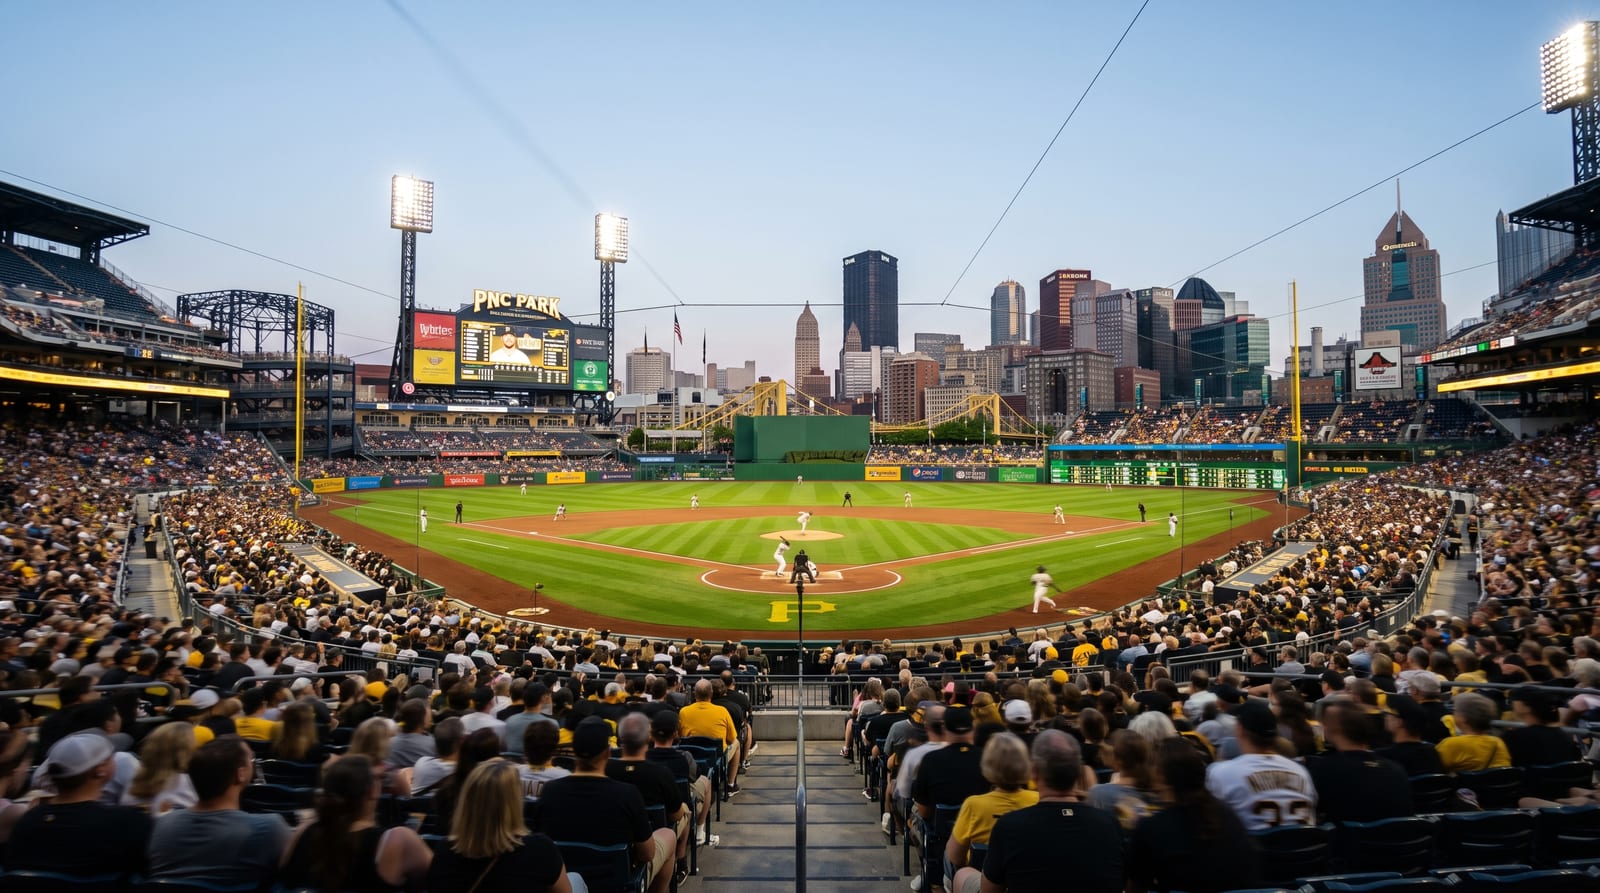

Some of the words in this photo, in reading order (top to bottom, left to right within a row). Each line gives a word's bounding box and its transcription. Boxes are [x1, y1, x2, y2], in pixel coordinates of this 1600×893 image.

[473, 288, 512, 313] PNC
[516, 294, 561, 321] PARK
[767, 600, 838, 623] P
